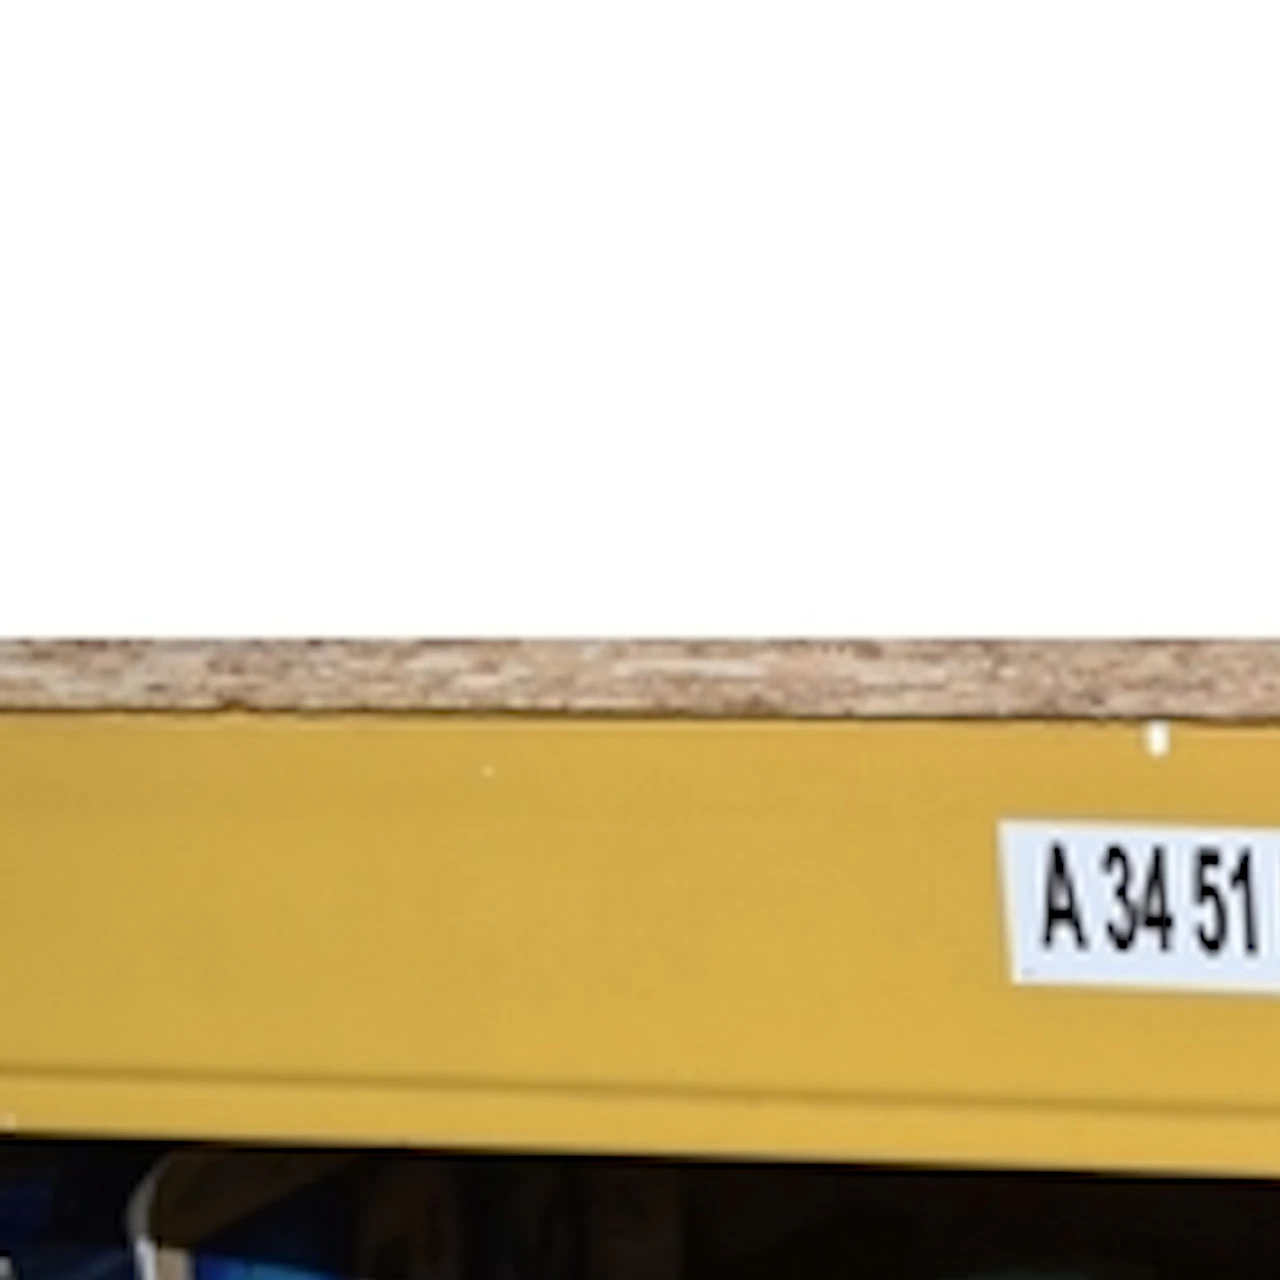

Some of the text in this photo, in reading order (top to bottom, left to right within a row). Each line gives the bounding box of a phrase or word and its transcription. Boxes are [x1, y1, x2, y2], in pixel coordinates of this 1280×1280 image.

[1041, 840, 1088, 951] A
[1102, 843, 1174, 952] 34
[1195, 846, 1257, 957] 51
